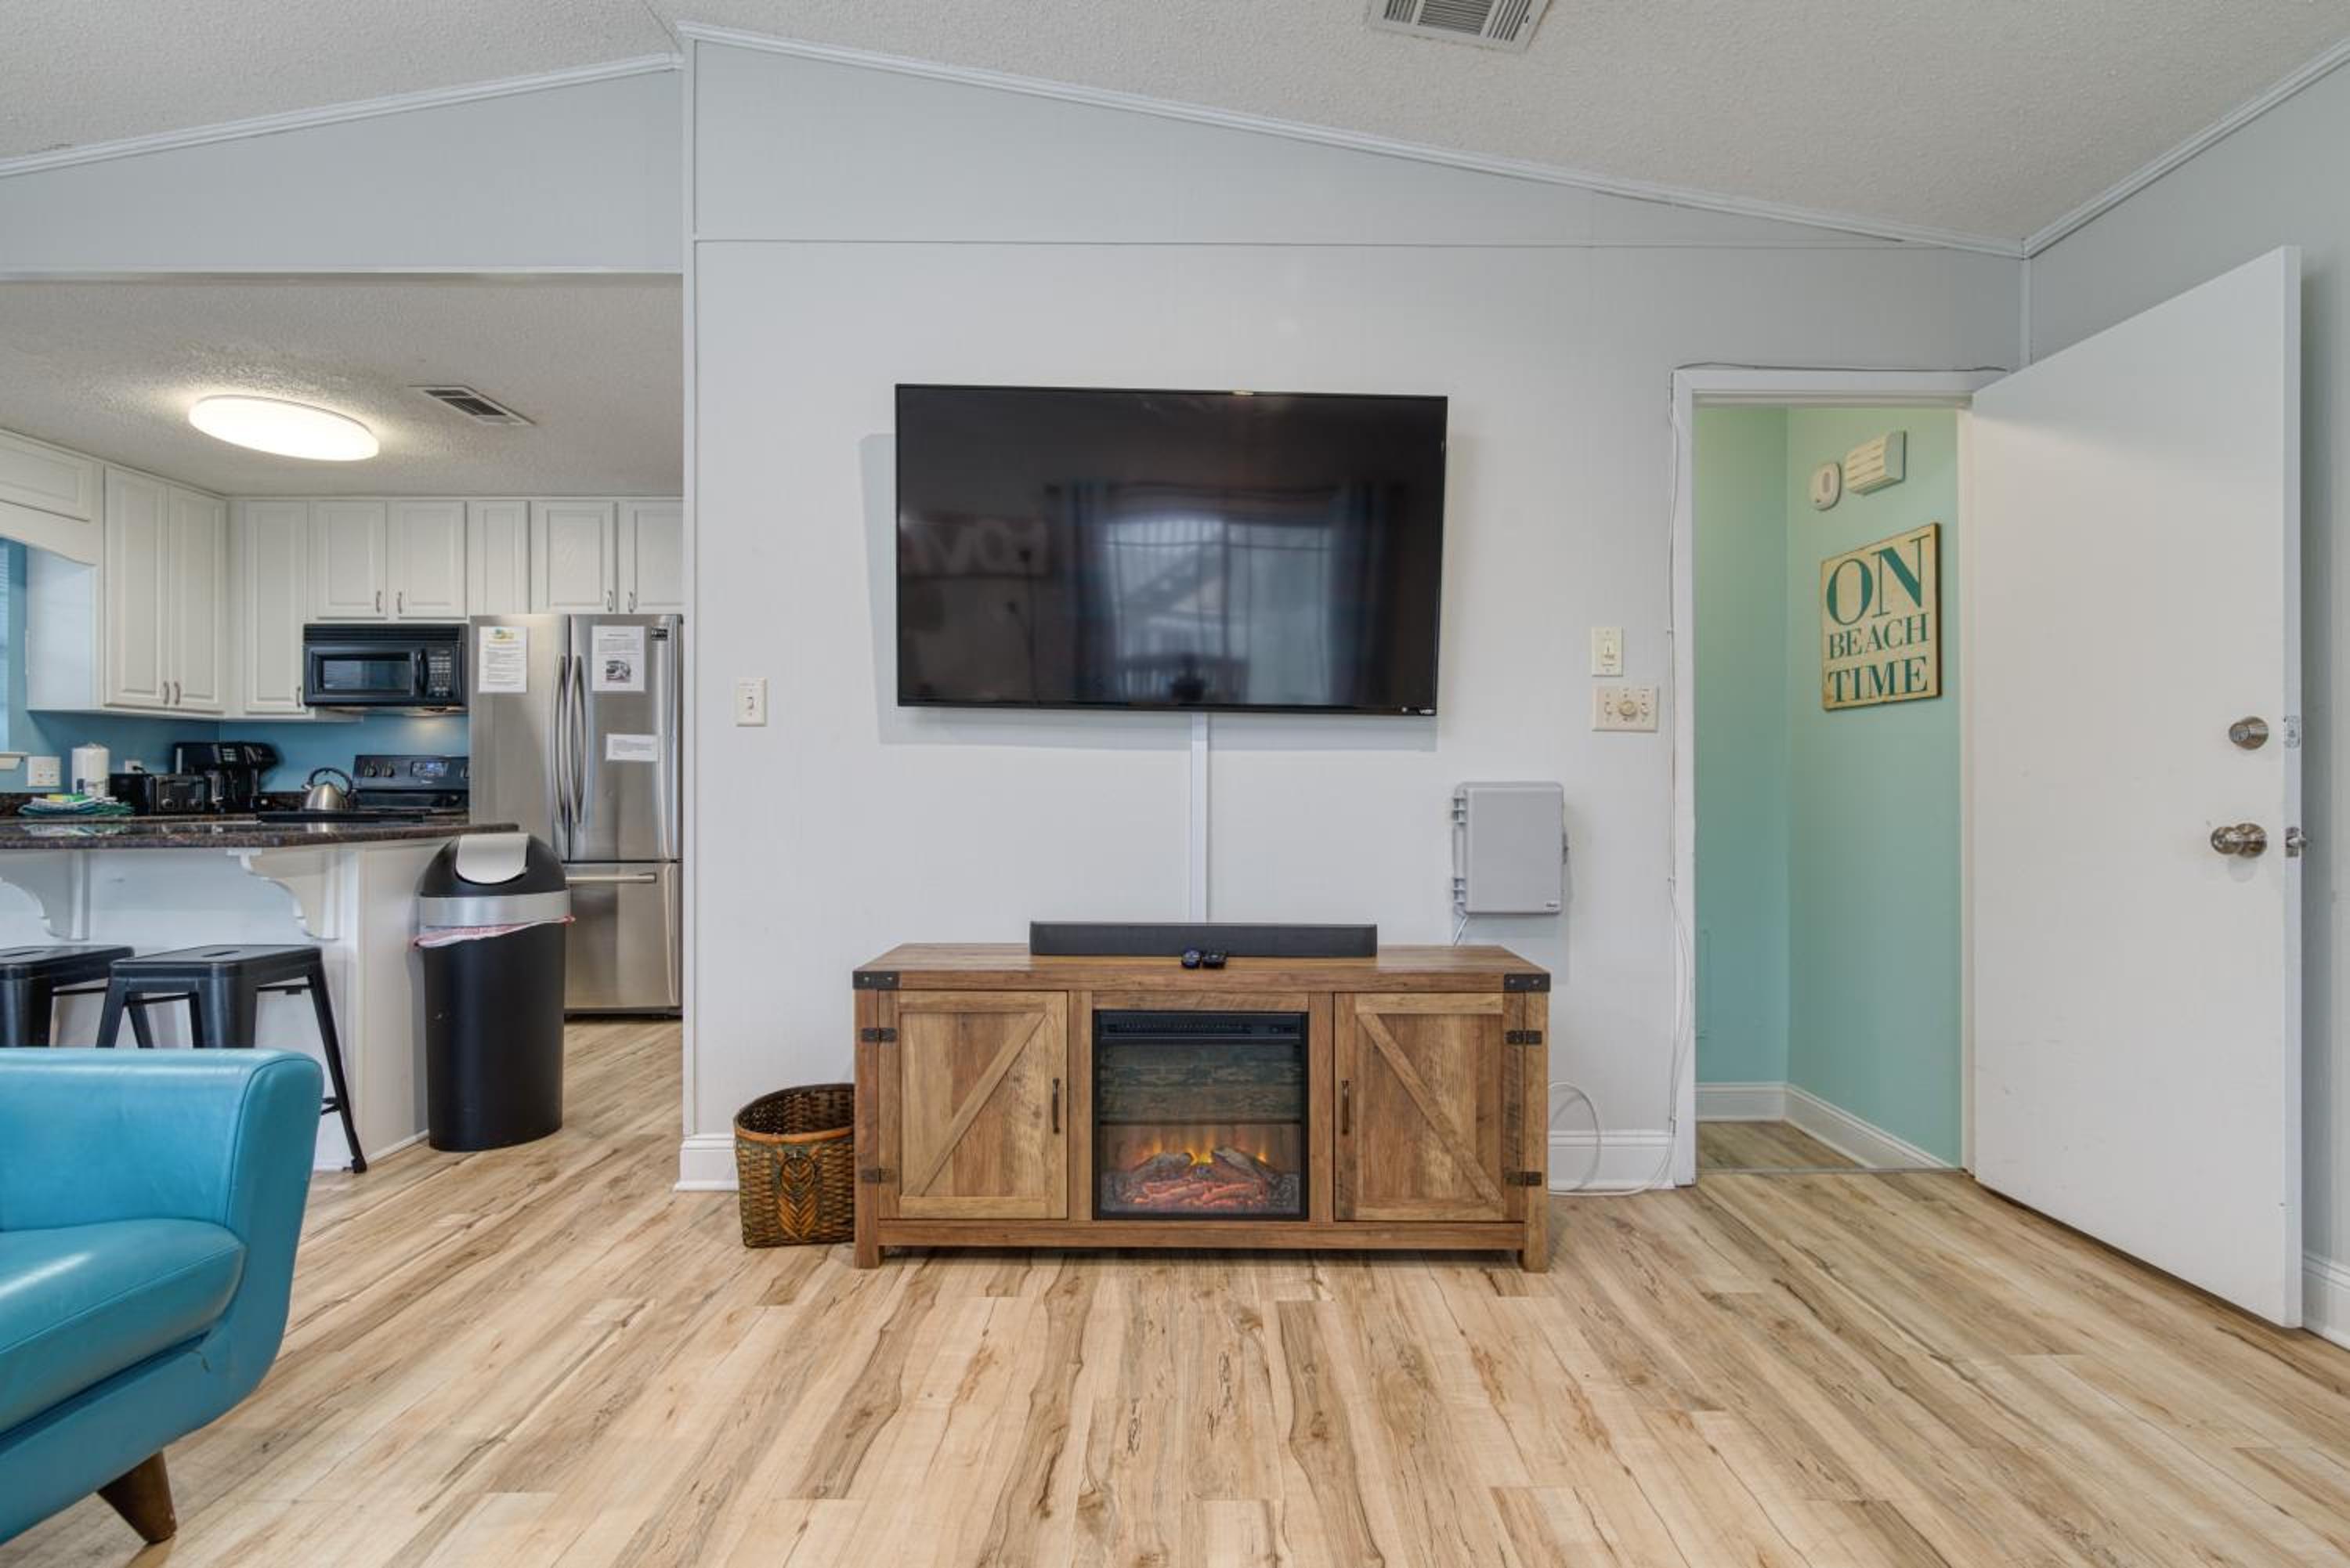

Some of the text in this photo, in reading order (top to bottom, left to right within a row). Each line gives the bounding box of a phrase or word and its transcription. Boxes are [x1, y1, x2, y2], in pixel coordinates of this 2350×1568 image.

[1826, 533, 1931, 626] ON
[1829, 613, 1930, 659] BEACH
[1828, 656, 1928, 703] TIME
